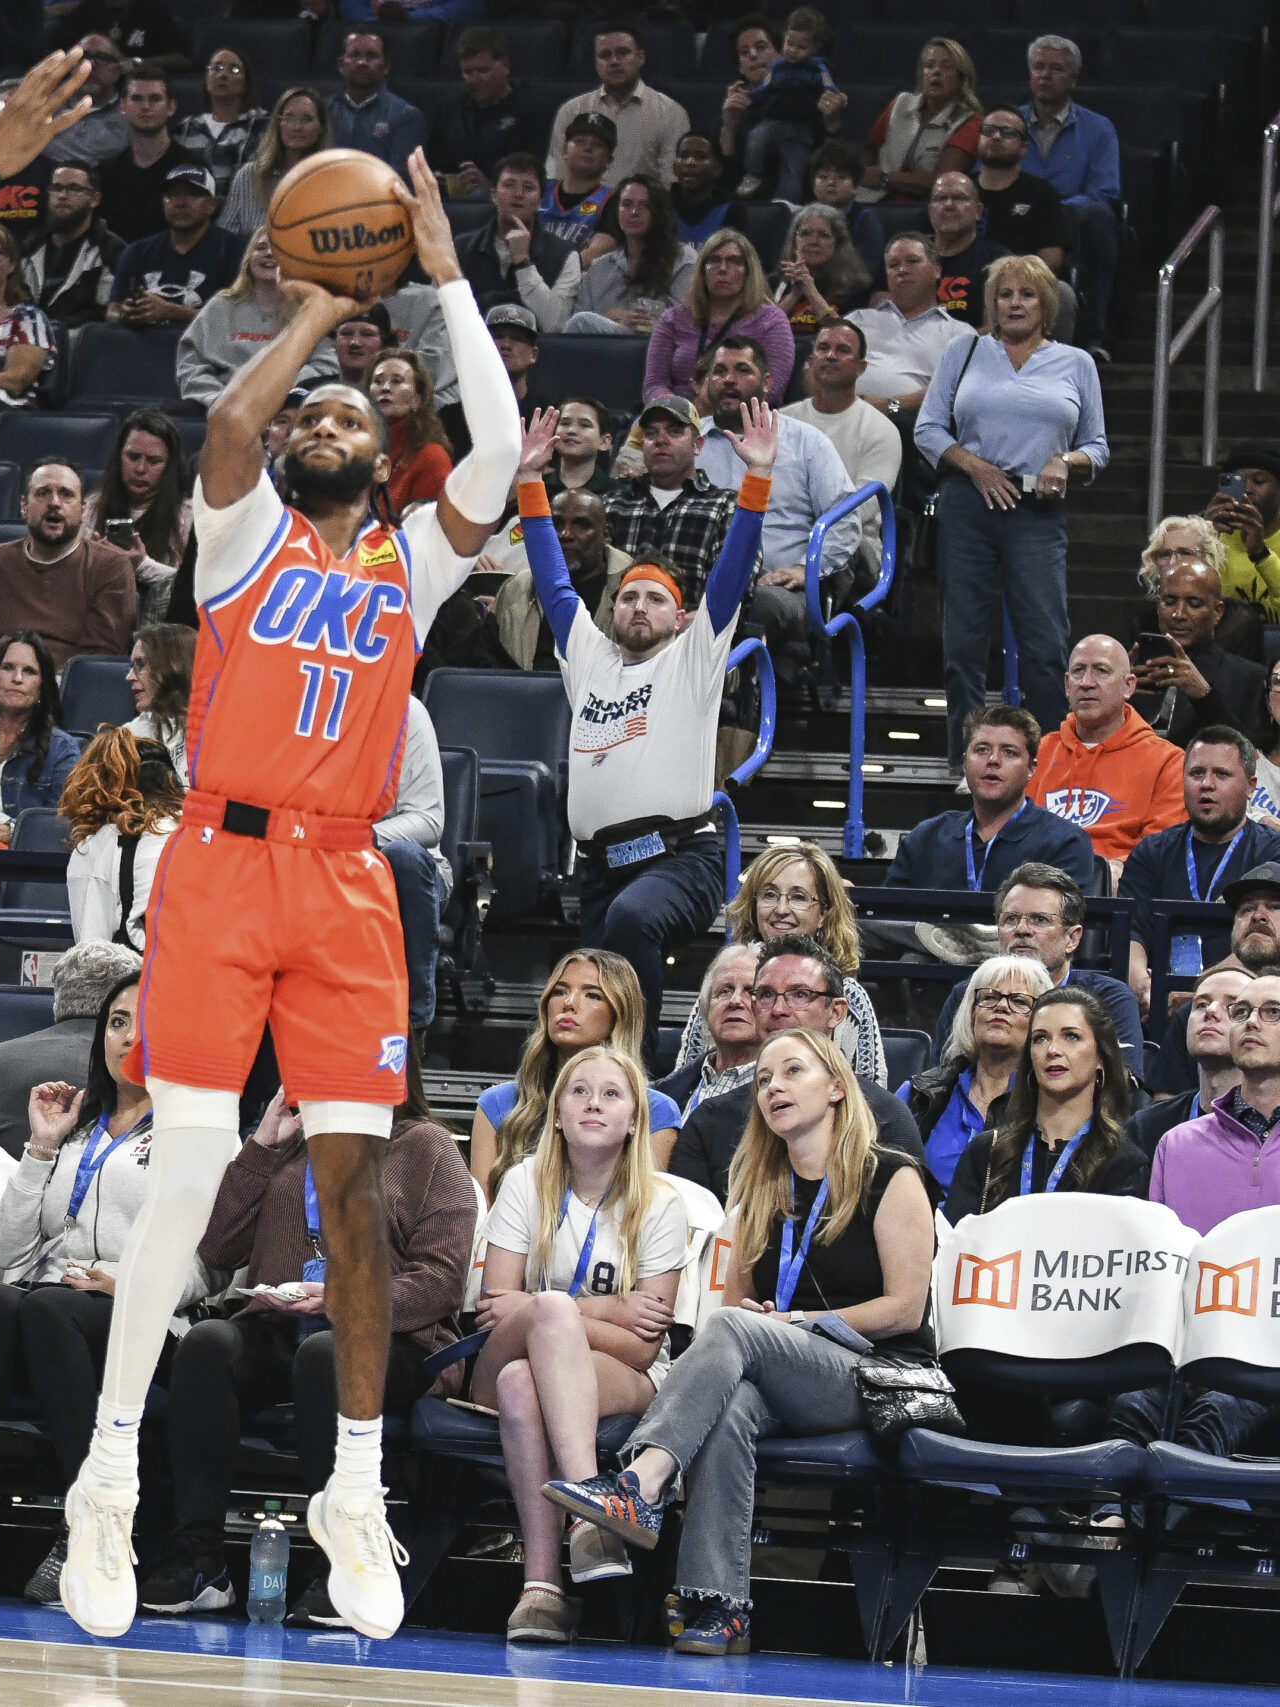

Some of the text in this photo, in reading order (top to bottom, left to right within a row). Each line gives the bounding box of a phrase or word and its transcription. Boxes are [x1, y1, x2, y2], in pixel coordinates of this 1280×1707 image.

[309, 223, 406, 254] Wilson
[249, 565, 407, 664] OKC
[295, 660, 353, 742] 11
[623, 844, 666, 865] CHASERS
[592, 1261, 616, 1295] 8
